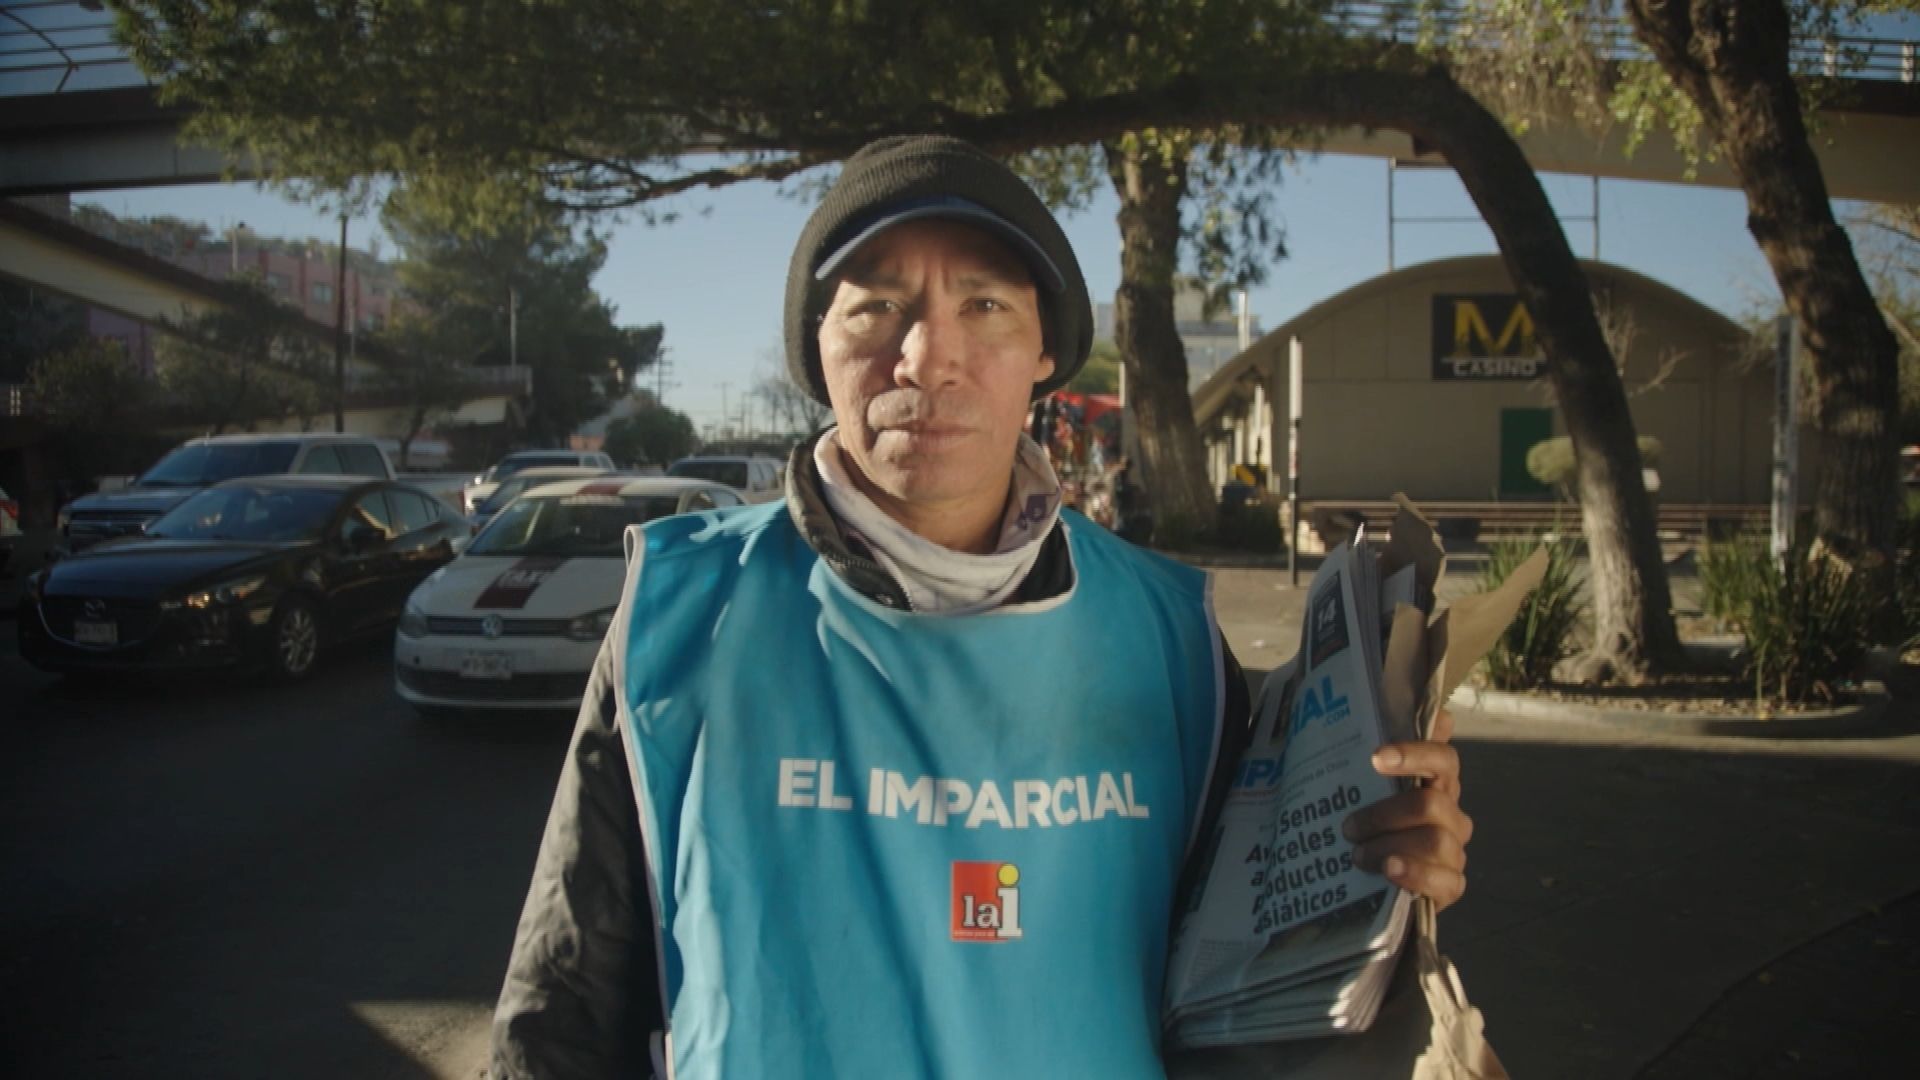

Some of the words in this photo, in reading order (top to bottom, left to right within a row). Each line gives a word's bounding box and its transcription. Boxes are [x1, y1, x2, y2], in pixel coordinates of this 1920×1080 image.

[1455, 300, 1535, 356] M
[1454, 357, 1536, 376] CASINO
[777, 757, 854, 810] EL
[867, 766, 1150, 829] IMPARCIAL
[1280, 785, 1361, 833] Senado
